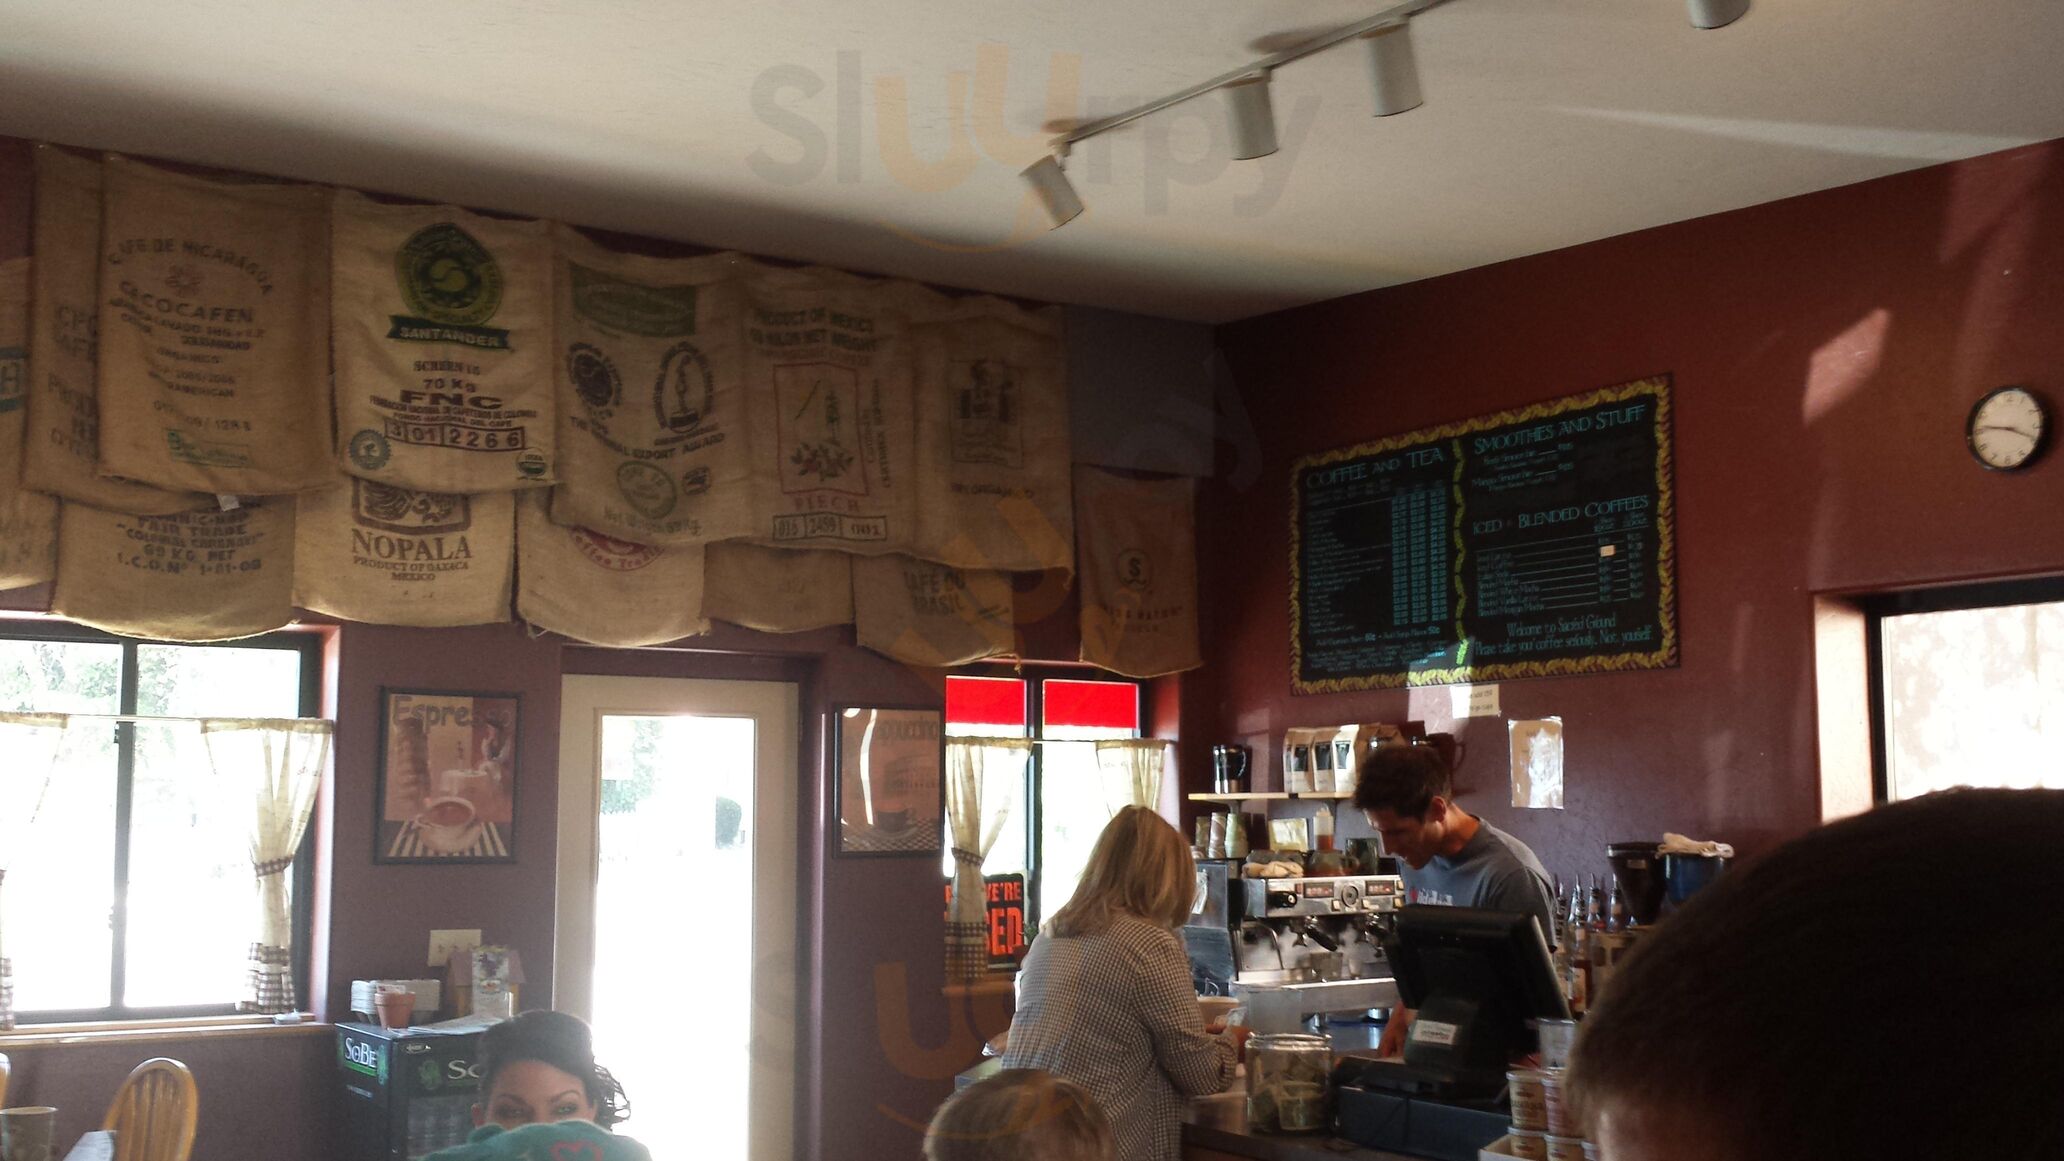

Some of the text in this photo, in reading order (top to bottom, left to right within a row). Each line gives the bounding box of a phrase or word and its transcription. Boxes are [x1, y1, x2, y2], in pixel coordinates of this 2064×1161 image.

[400, 326, 500, 347] SANTANDER
[423, 378, 445, 390] 70
[400, 389, 504, 410] FNC
[1558, 416, 1592, 436] AND
[1595, 404, 1646, 431] STUFF
[1306, 447, 1444, 489] COFFEE AND TEA
[1473, 519, 1503, 536] ICED
[1517, 505, 1581, 529] BLENDED
[1584, 495, 1650, 518] COFFEES
[352, 528, 473, 562] NOPALA
[208, 550, 236, 562] NET
[354, 556, 470, 573] PRODUCT OF OAXACA
[391, 571, 437, 582] MEXICO
[1506, 621, 1542, 638] Welcome
[1585, 611, 1617, 630] Ground
